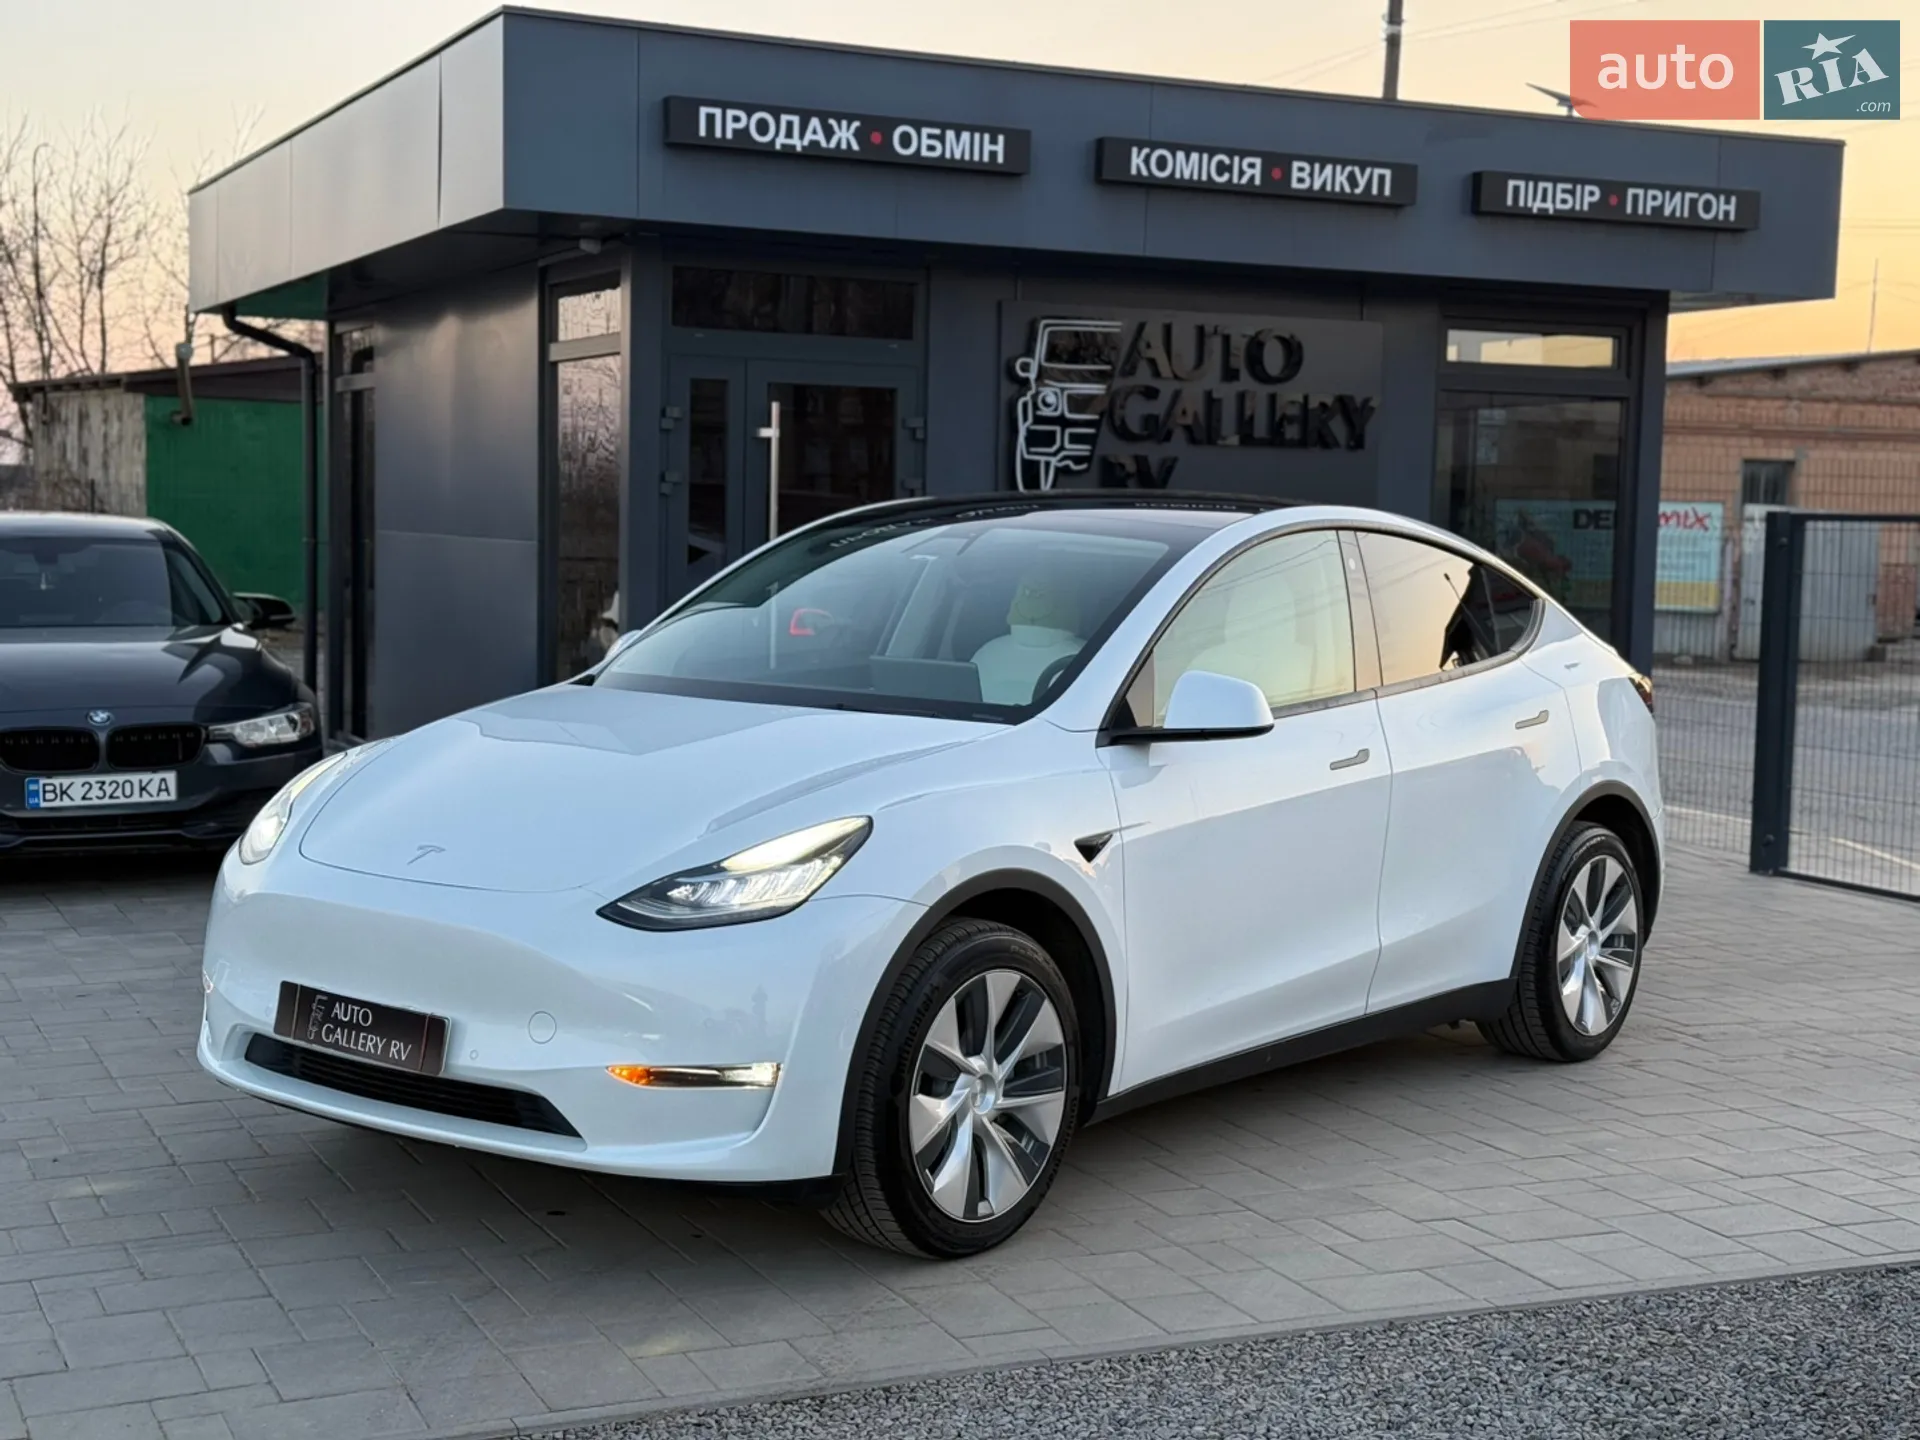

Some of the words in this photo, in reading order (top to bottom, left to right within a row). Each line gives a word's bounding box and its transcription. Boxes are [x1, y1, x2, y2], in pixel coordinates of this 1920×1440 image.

[699, 106, 861, 152] ПРОДАЖ
[892, 125, 1005, 164] ОБМІН
[1130, 146, 1262, 186] КОМІСІЯ
[1290, 160, 1392, 196] ВИКУП
[1506, 179, 1601, 214] ПІДБІР
[1626, 187, 1737, 222] ПРИГОН
[1123, 321, 1303, 384] AUTO
[1108, 385, 1374, 450] GALLERY
[42, 781, 76, 803] BK
[80, 779, 135, 800] 2320
[139, 777, 172, 798] KA
[331, 1001, 373, 1027] AUTO
[321, 1023, 387, 1056] GALLERY
[389, 1040, 412, 1061] RV
